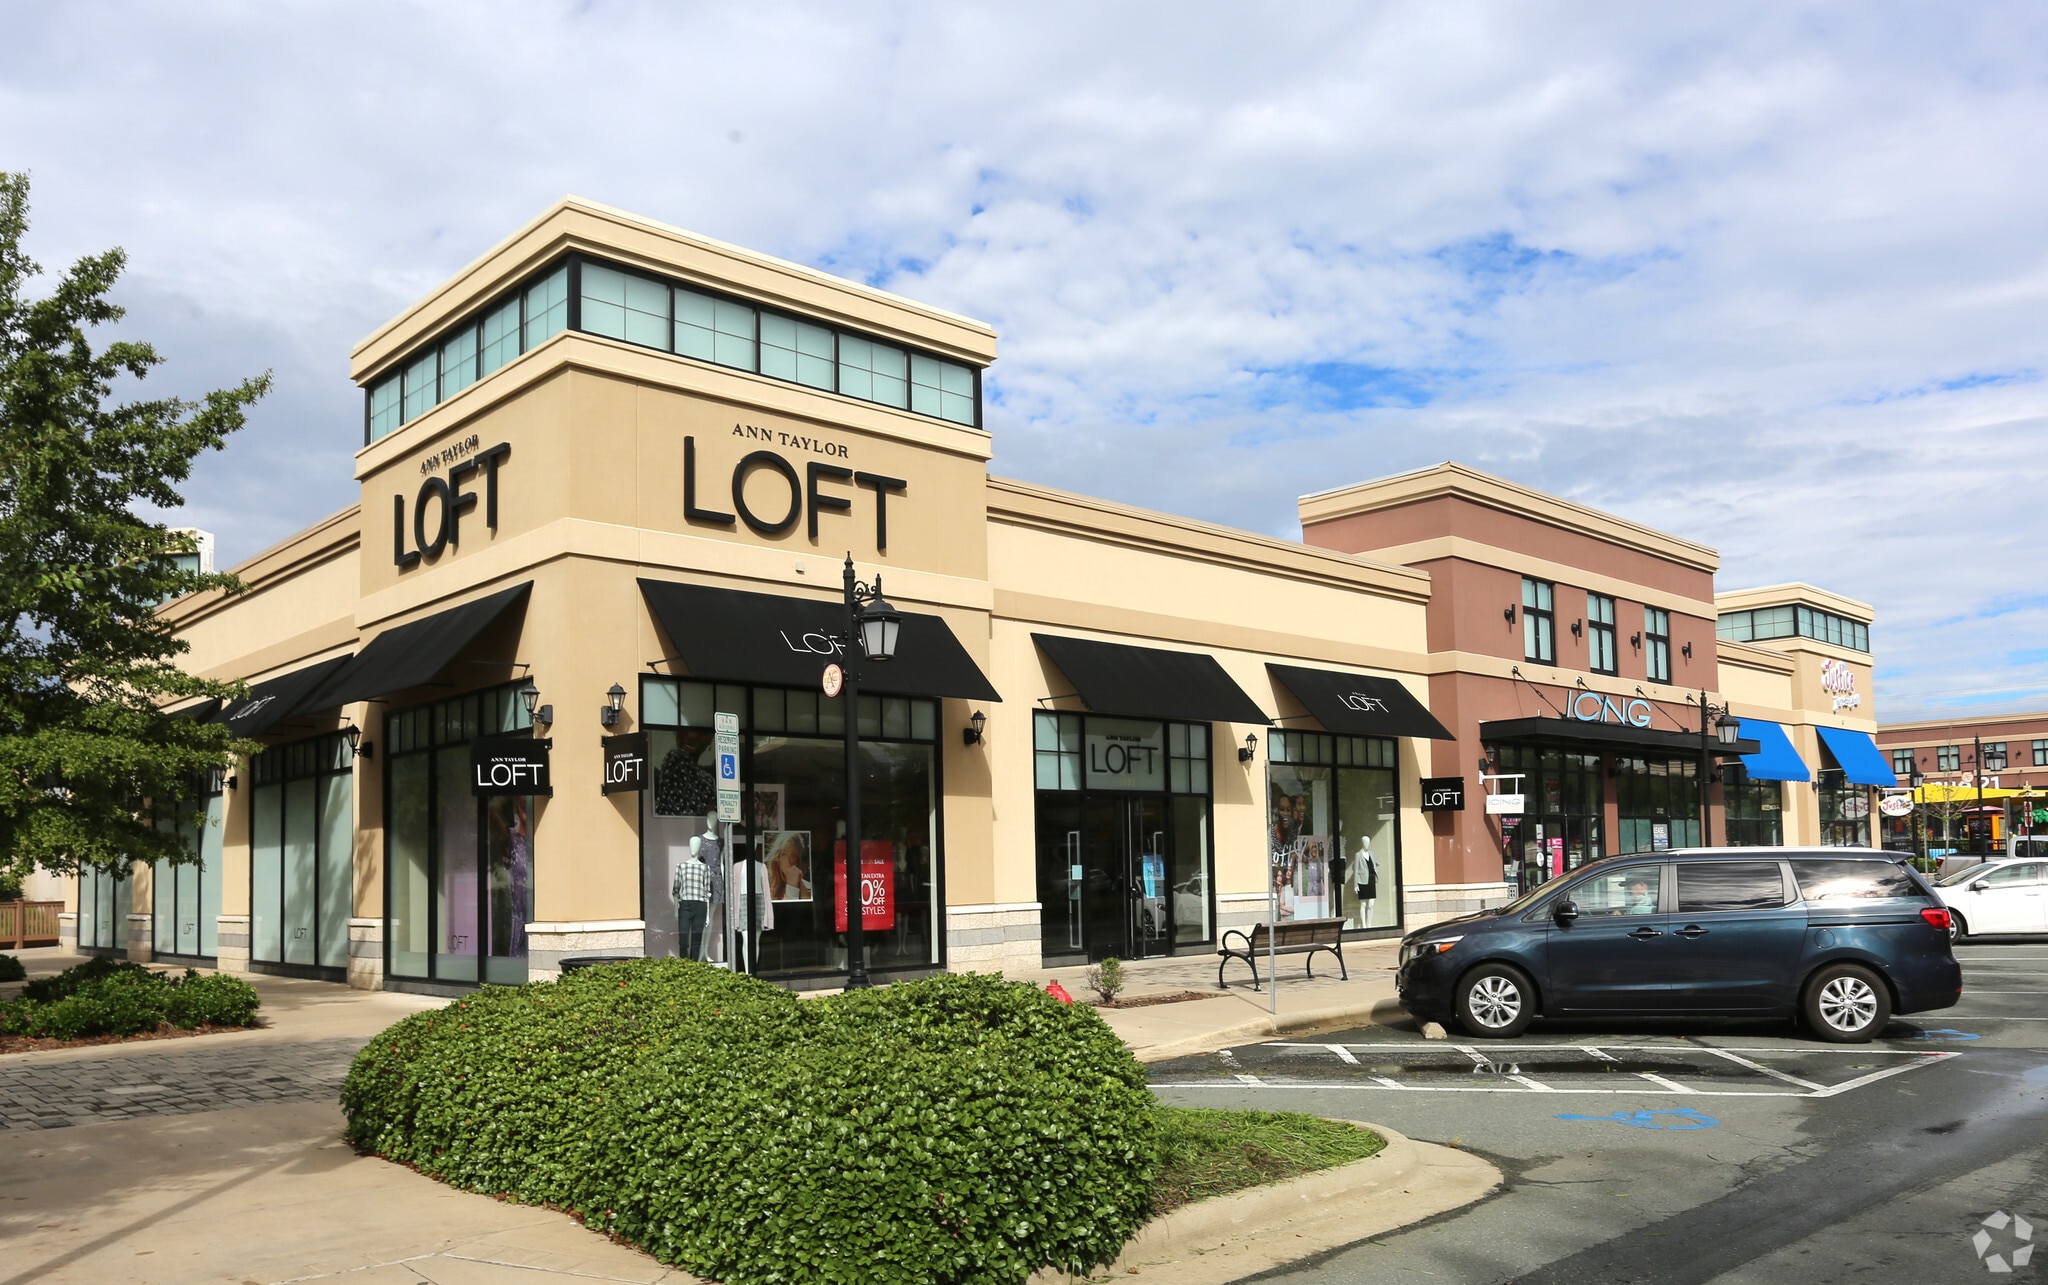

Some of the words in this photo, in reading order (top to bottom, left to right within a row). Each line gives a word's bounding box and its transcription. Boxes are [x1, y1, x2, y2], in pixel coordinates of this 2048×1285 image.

[732, 423, 772, 442] ANN
[778, 432, 849, 458] TAYLOR
[420, 453, 440, 476] ANN
[441, 434, 479, 463] TAYLOR
[394, 441, 511, 567] LOFT
[684, 436, 907, 551] LOFT
[780, 630, 863, 656] LOF
[1337, 694, 1389, 713] LOFT
[718, 735, 737, 745] RESERVED
[718, 744, 737, 754] PARKING
[606, 758, 643, 783] LOFT
[1092, 743, 1159, 775] LOFT
[477, 763, 544, 786] LOFT
[1424, 791, 1461, 806] LOFT
[861, 879, 886, 906] 0%
[873, 897, 886, 905] OFF
[862, 906, 886, 915] STYLES
[447, 934, 469, 950] LOFT
